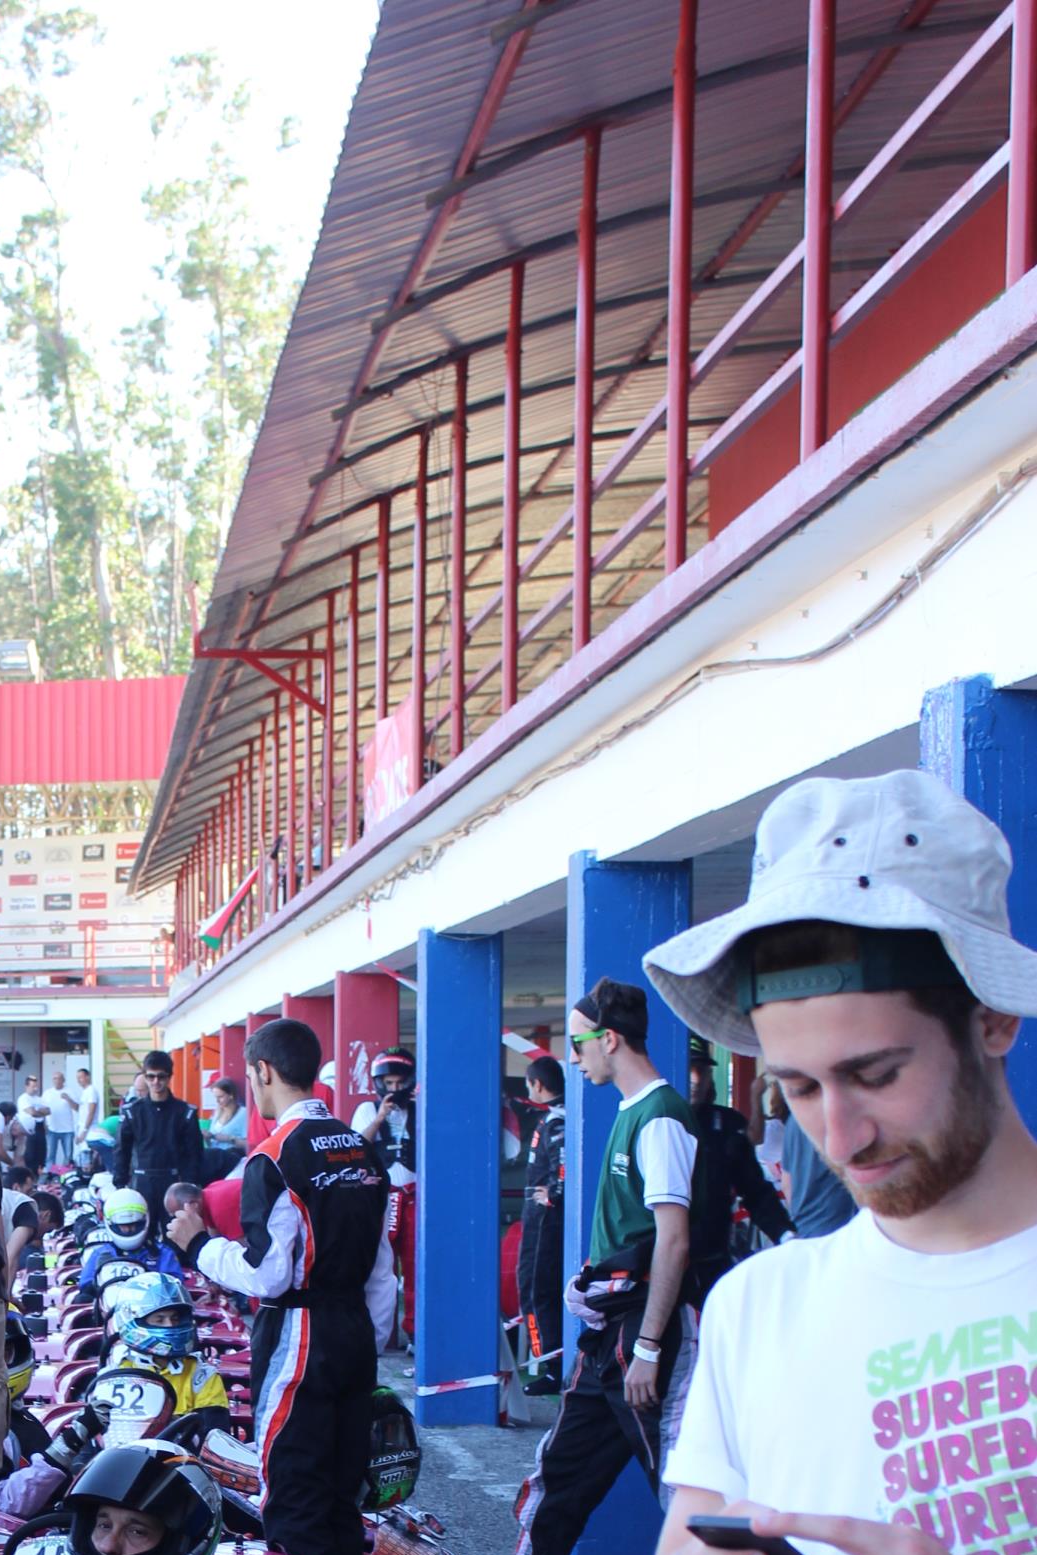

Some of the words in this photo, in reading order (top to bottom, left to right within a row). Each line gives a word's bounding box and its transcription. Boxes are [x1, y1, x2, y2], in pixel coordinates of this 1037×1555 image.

[310, 1134, 363, 1152] KEYSTONE
[110, 1384, 145, 1409] 52
[867, 1311, 1037, 1398] SEMEN
[871, 1364, 1037, 1450] SURFB
[881, 1416, 1037, 1503] SURFB
